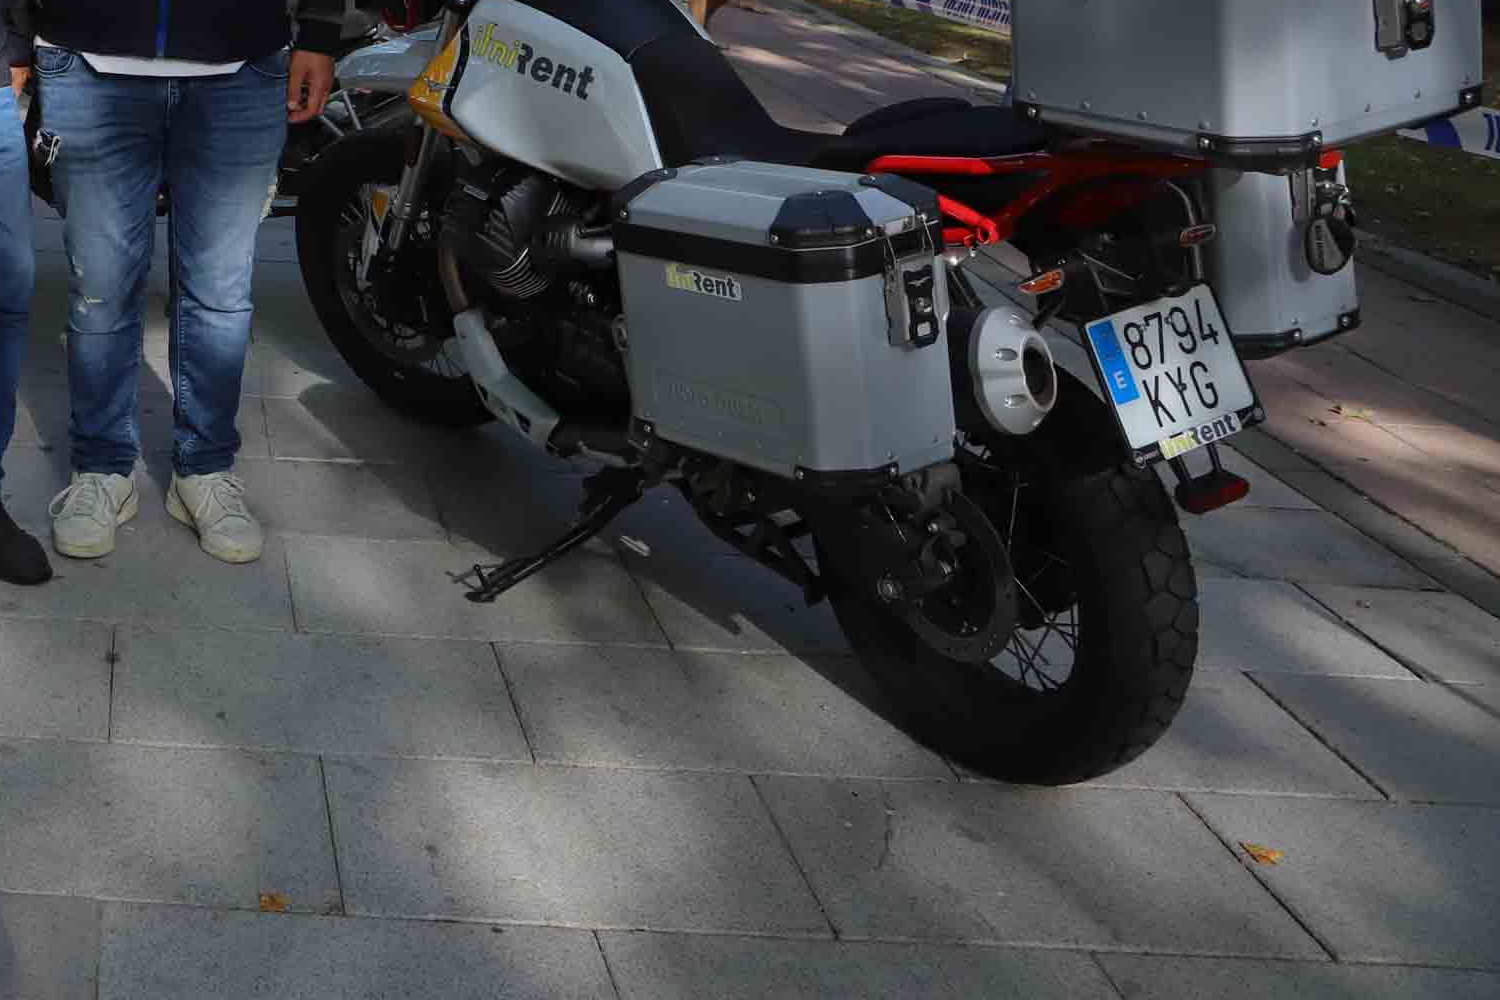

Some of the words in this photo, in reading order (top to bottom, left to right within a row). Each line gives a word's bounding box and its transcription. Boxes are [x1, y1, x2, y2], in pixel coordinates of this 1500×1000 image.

[1123, 298, 1220, 370] 8794
[1112, 369, 1128, 390] E
[1142, 360, 1219, 428] KYG
